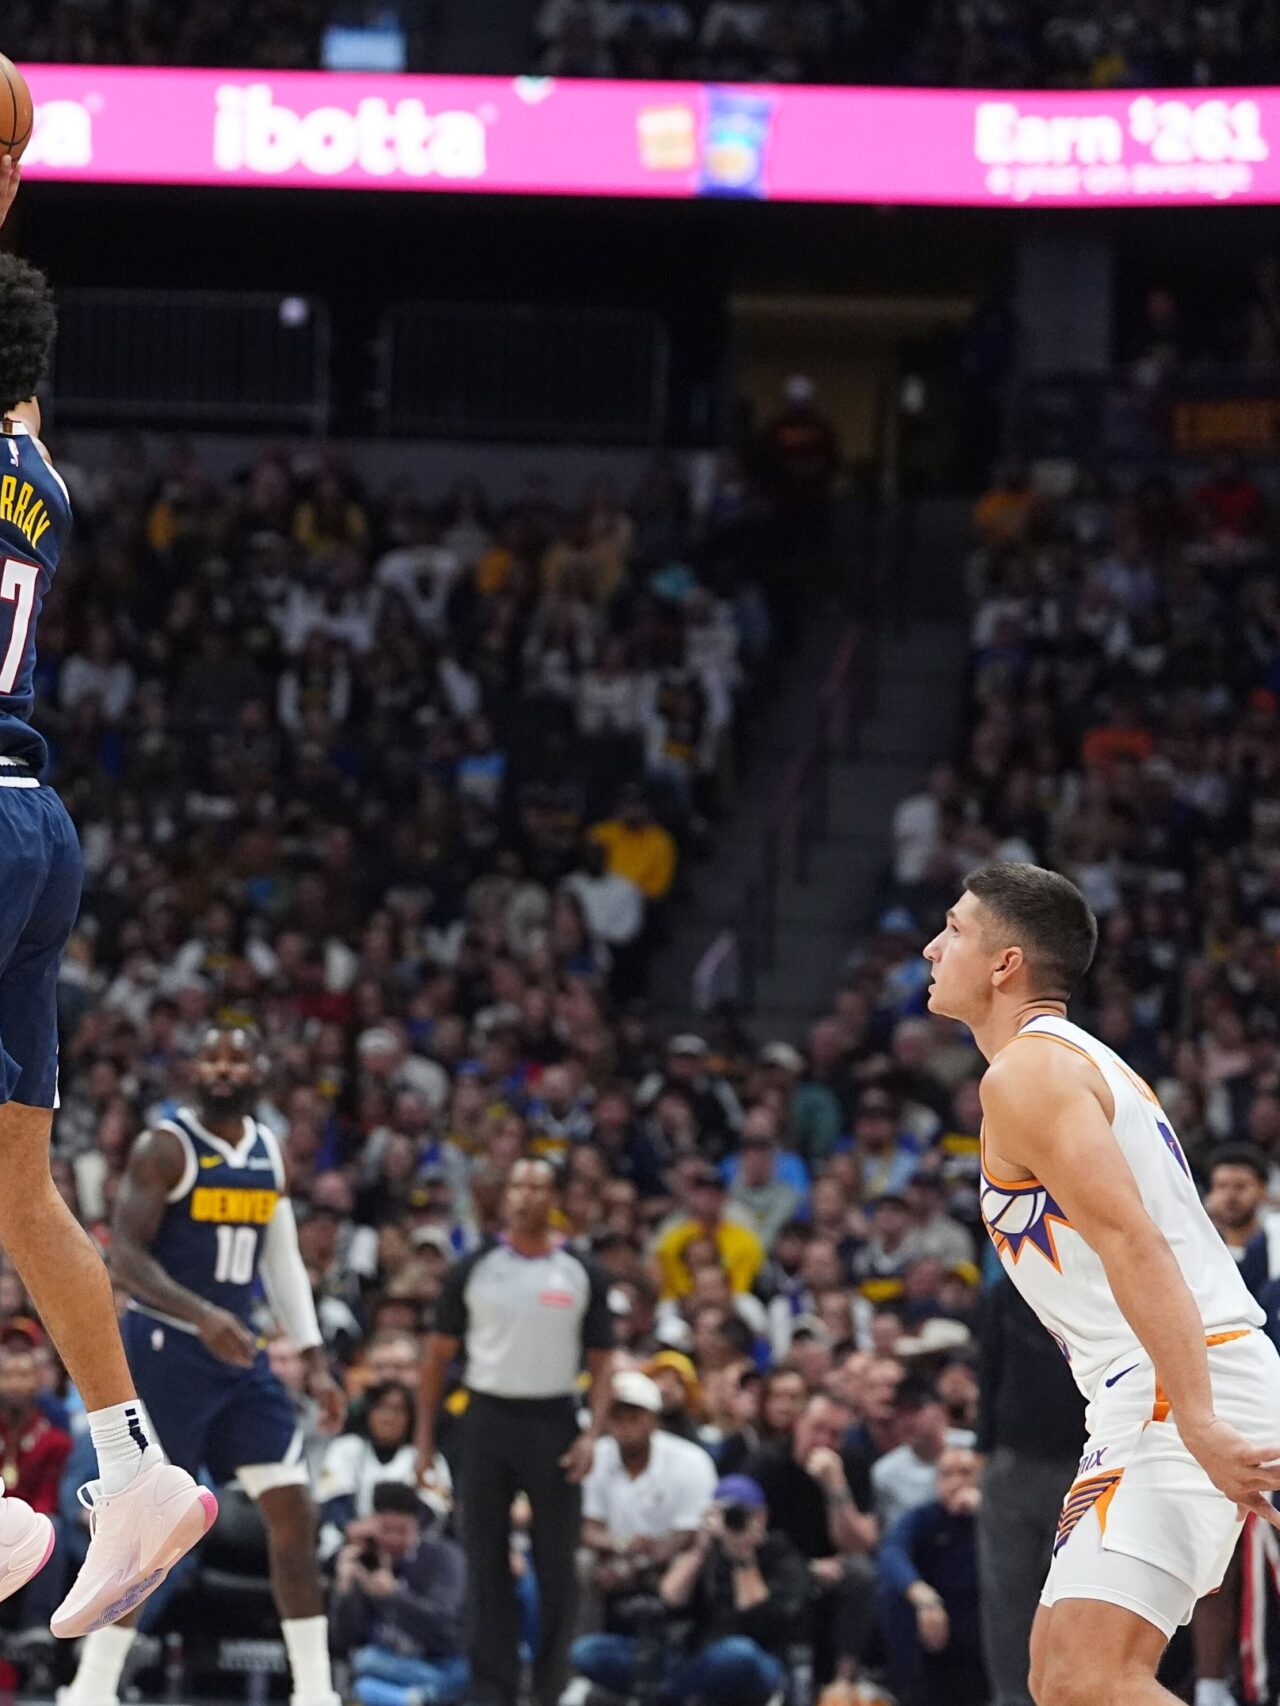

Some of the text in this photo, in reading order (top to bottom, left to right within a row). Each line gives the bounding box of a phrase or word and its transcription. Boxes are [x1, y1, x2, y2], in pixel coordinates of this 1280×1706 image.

[214, 83, 486, 179] ibotta
[974, 95, 1269, 165] Earn $261
[214, 1224, 257, 1285] 10
